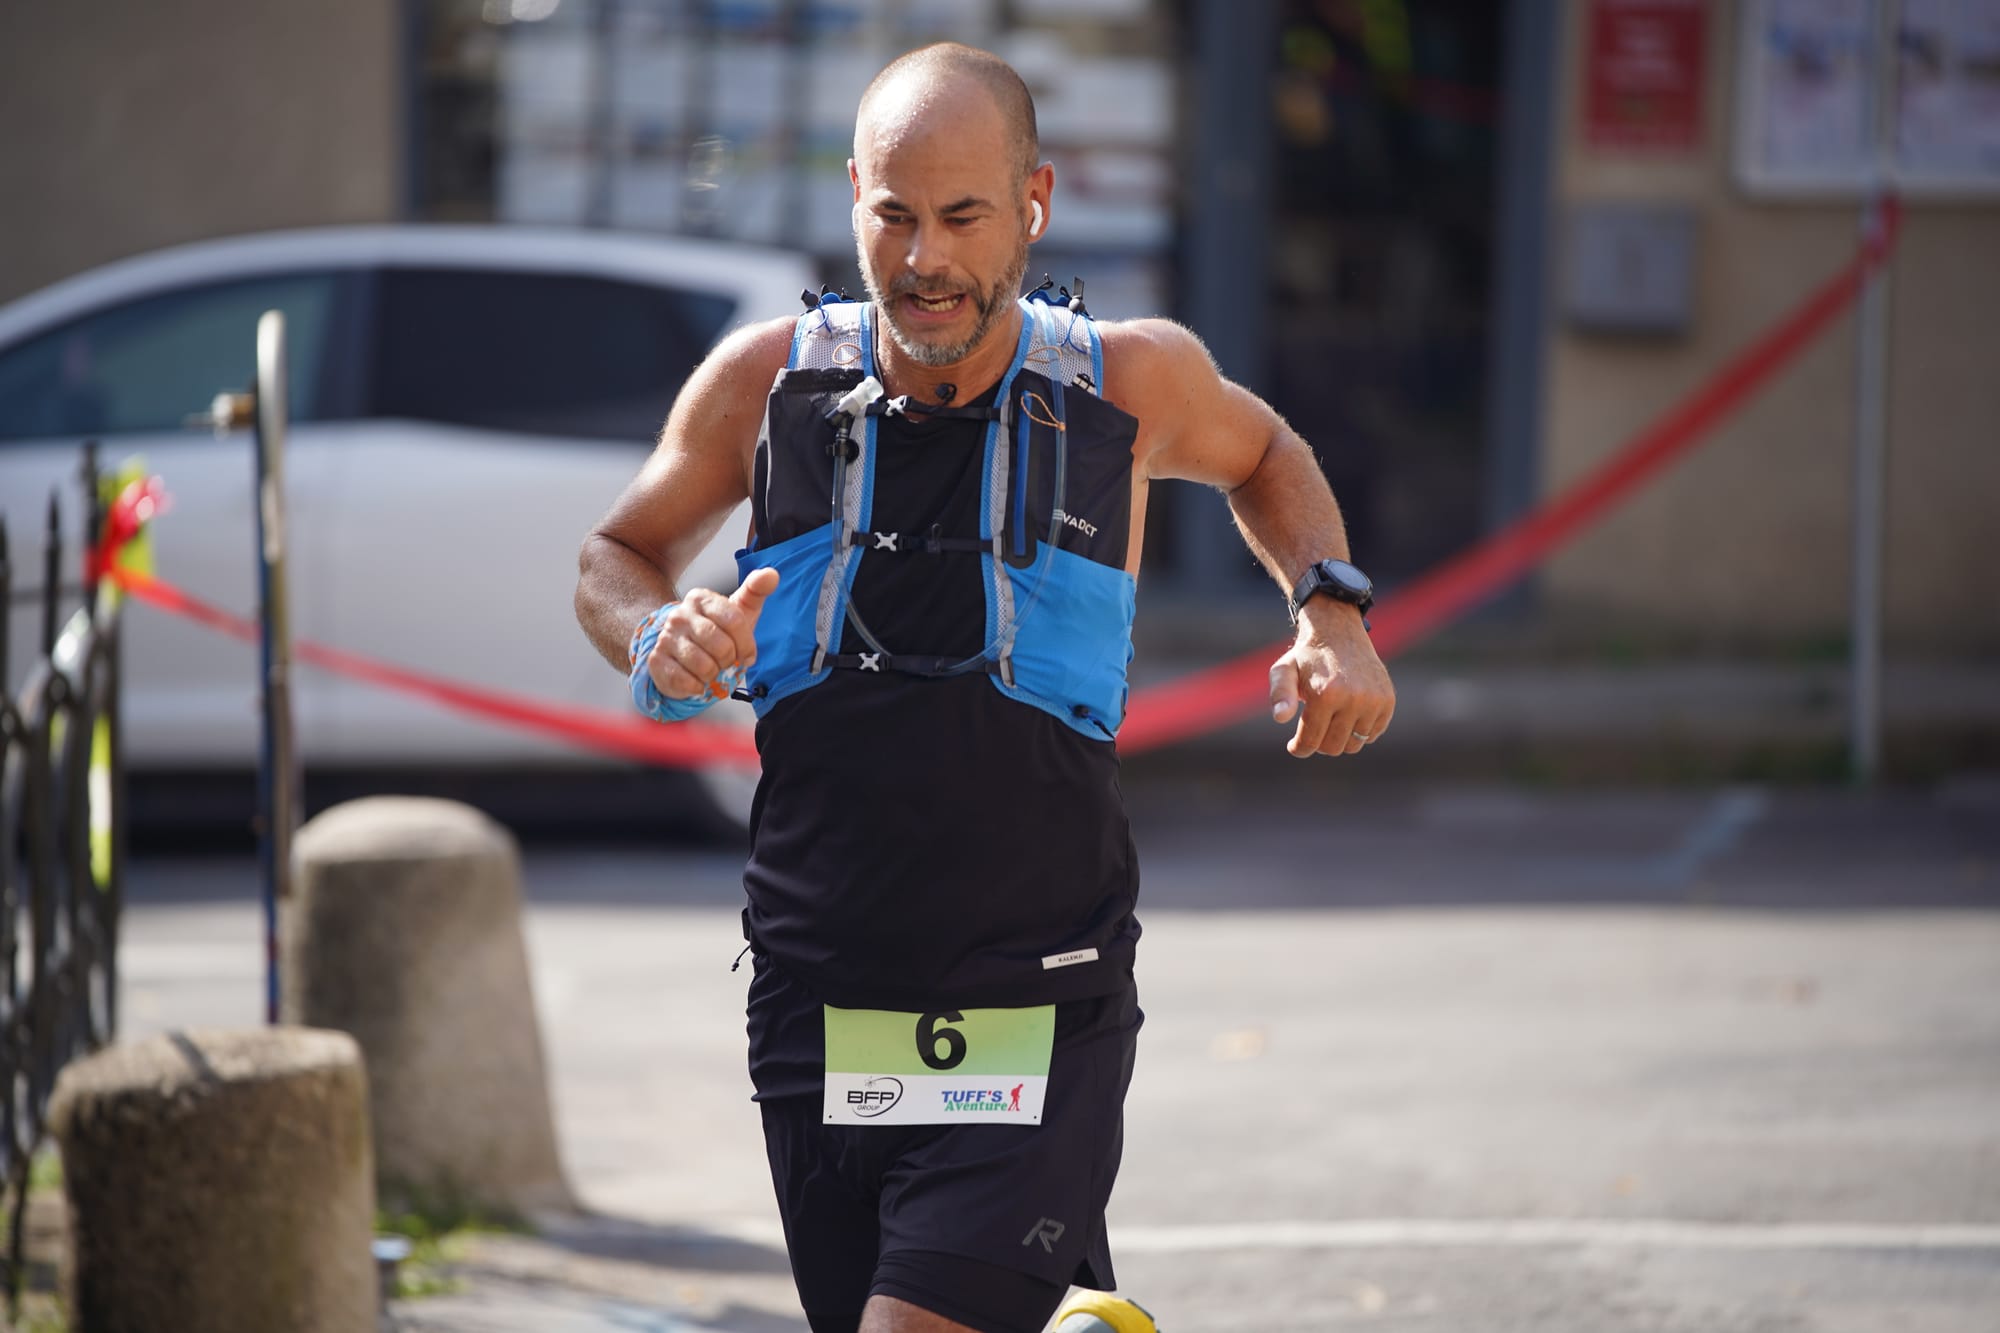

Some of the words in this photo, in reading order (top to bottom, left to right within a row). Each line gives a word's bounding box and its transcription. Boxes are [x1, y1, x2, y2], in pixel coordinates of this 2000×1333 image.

[915, 1009, 967, 1070] 6
[847, 1090, 894, 1104] BFP
[941, 1090, 1003, 1103] TUFF'S
[944, 1100, 1008, 1112] Aventure
